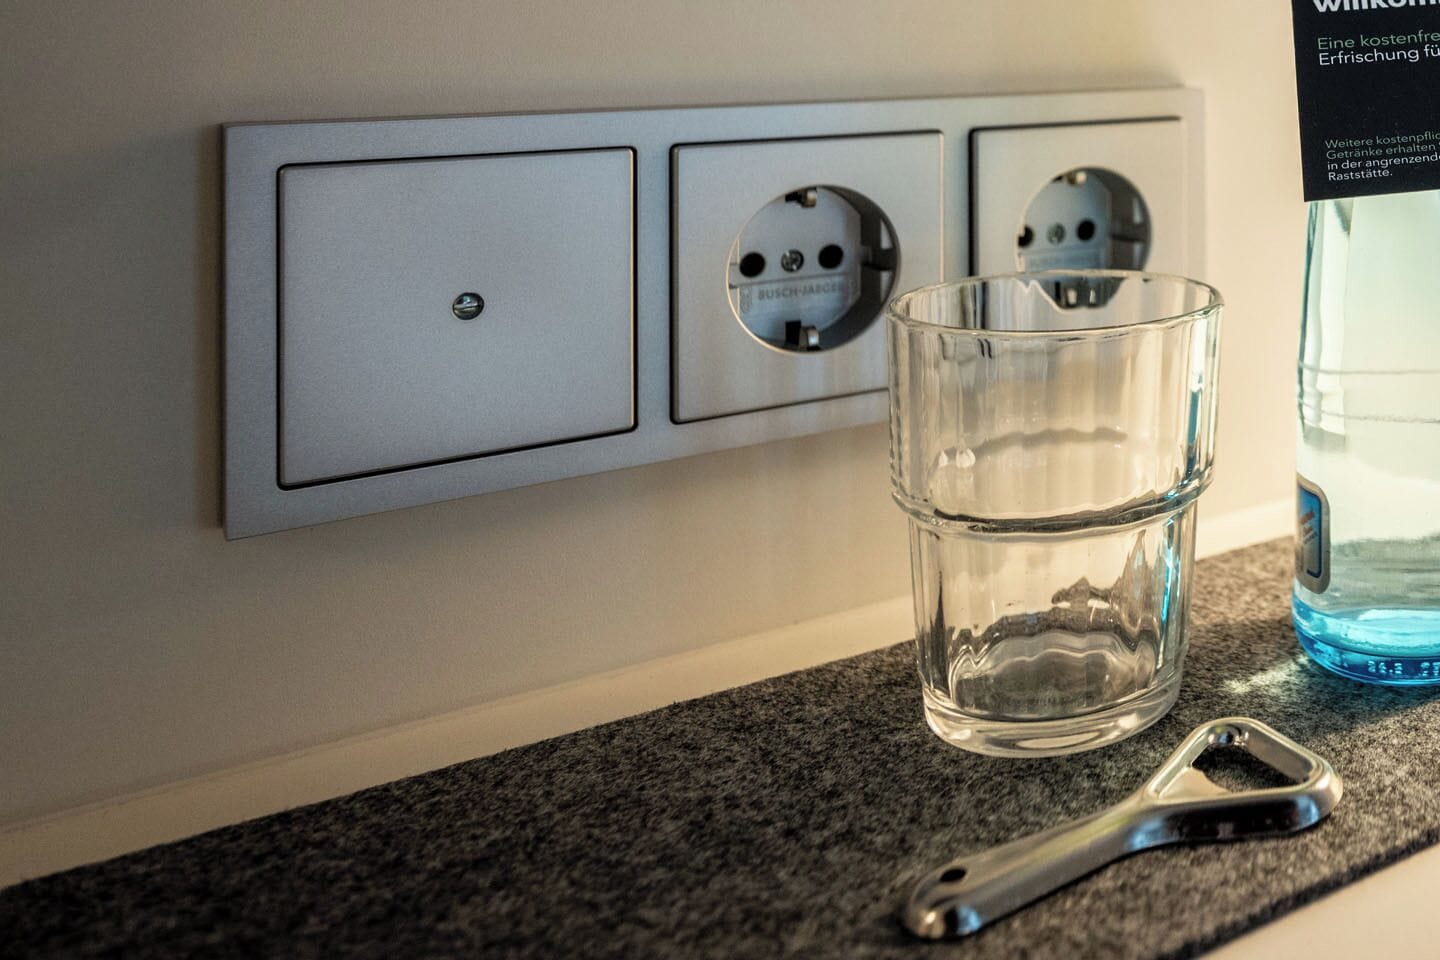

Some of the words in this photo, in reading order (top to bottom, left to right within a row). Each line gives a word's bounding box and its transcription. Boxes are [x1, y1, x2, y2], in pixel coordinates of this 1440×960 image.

[1317, 36, 1355, 50] Eine
[1319, 46, 1420, 66] Erfrischung
[1325, 137, 1374, 149] Weitere
[1326, 146, 1383, 160] Getränke
[1385, 141, 1436, 155] erhalten
[1327, 160, 1338, 171] in
[1341, 158, 1362, 170] der
[1328, 168, 1393, 182] Raststätte.
